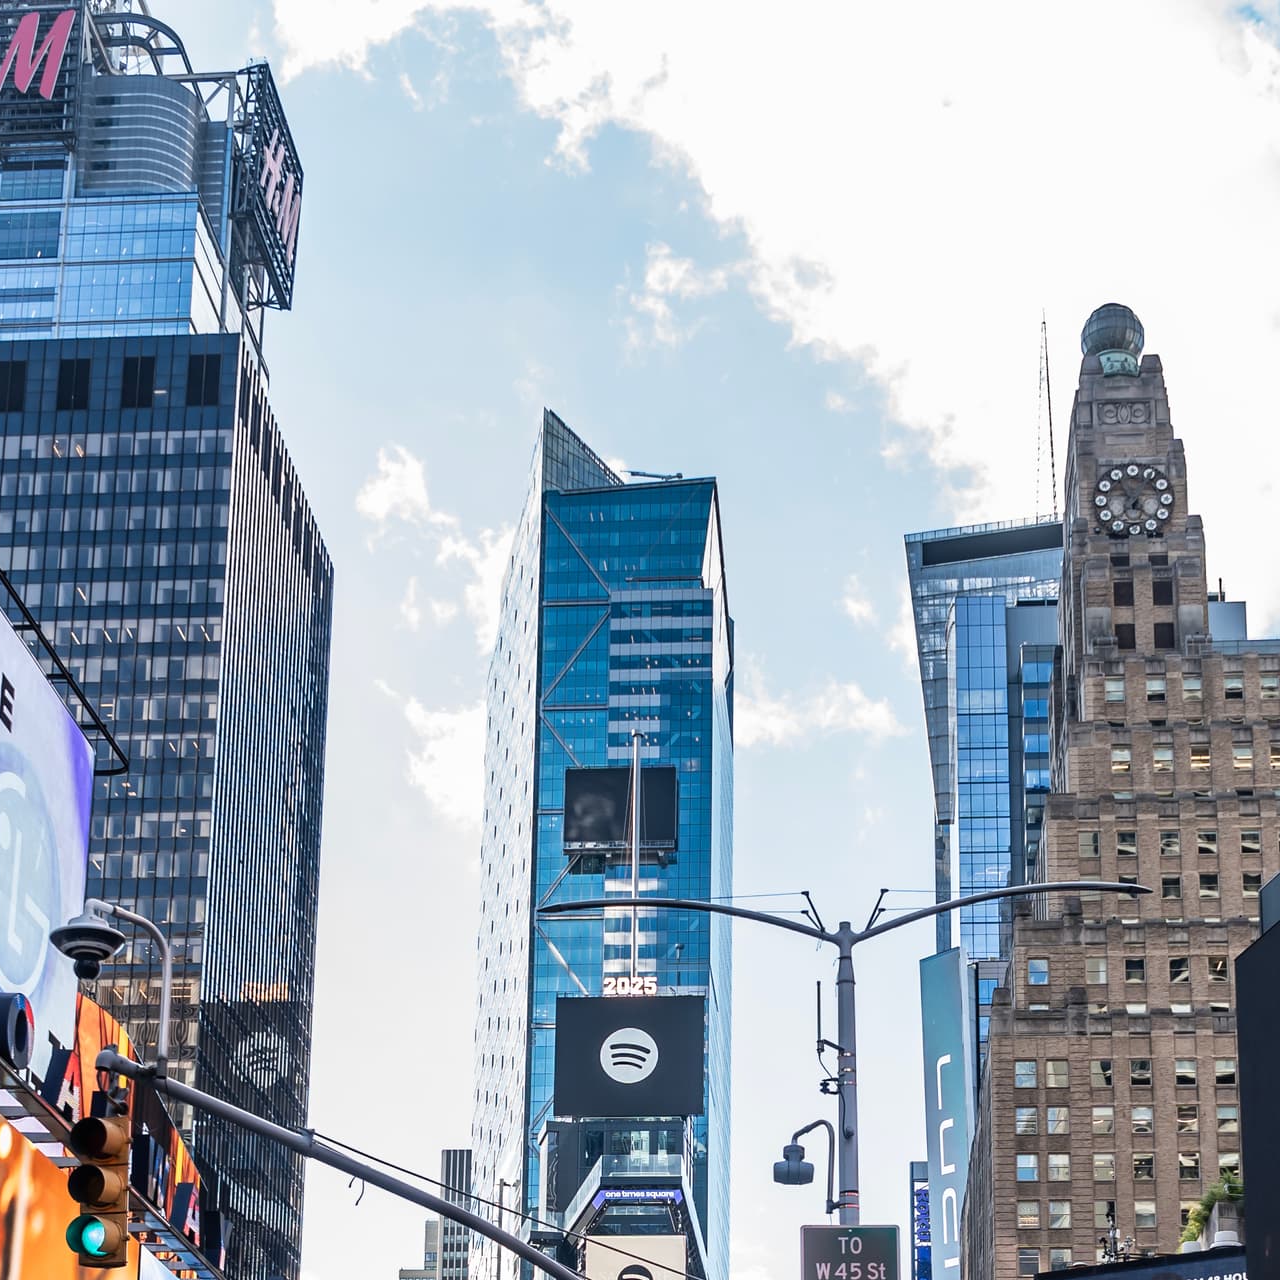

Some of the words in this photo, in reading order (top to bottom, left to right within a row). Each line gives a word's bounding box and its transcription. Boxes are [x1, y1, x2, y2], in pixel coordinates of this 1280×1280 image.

[603, 977, 657, 995] 2025
[838, 1237, 862, 1255] TO
[815, 1263, 832, 1280] W
[834, 1263, 863, 1280] 45
[867, 1262, 887, 1280] St
